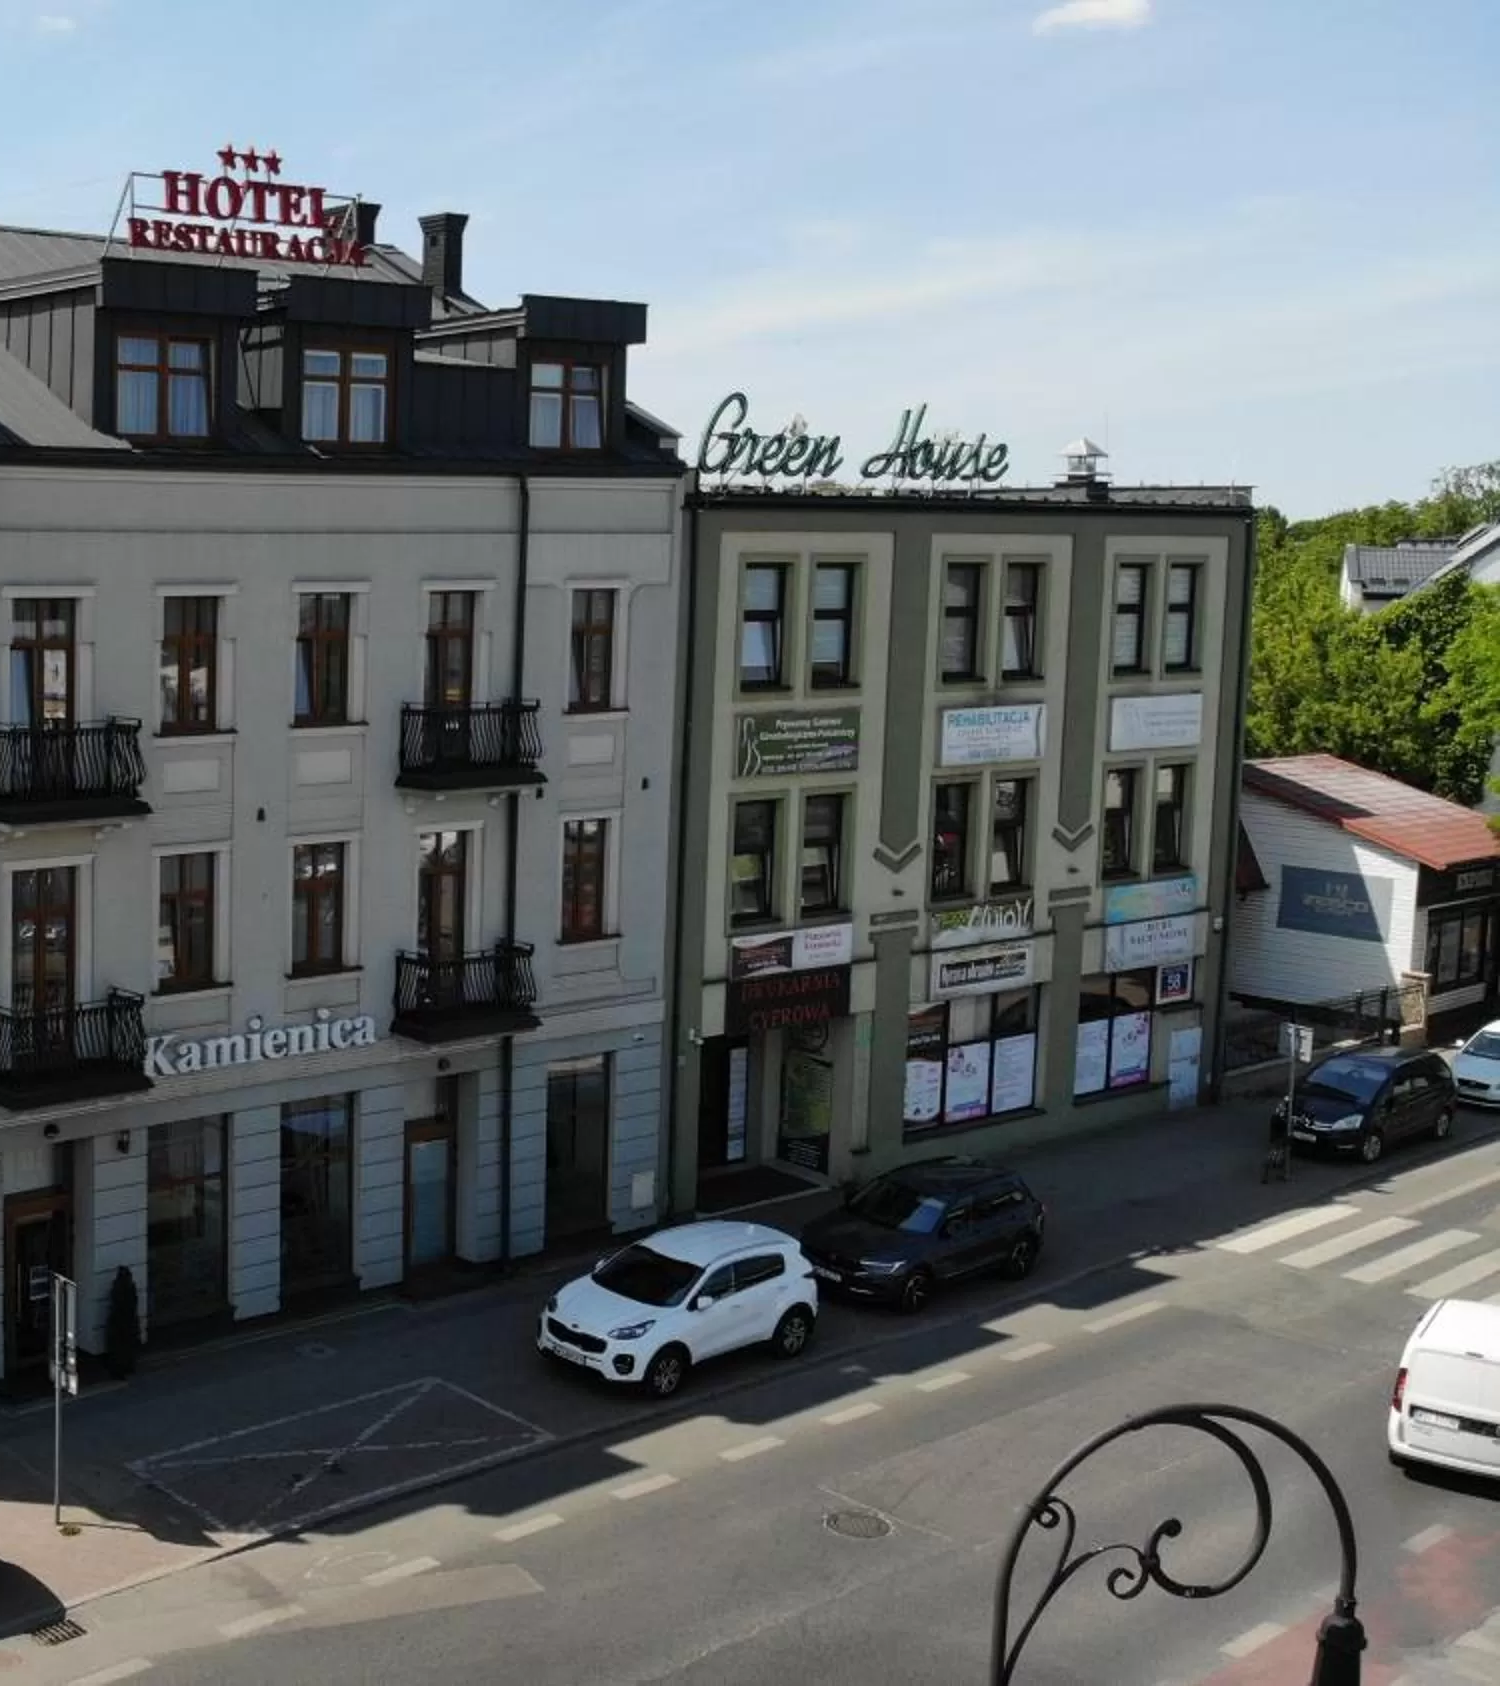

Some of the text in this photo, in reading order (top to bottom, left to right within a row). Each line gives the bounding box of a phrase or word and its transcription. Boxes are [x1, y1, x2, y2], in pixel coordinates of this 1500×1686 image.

[162, 170, 337, 229] HOTEL
[127, 218, 373, 268] RESTAURACJA
[698, 391, 1009, 482] Green House
[143, 1007, 376, 1078] Kamienica
